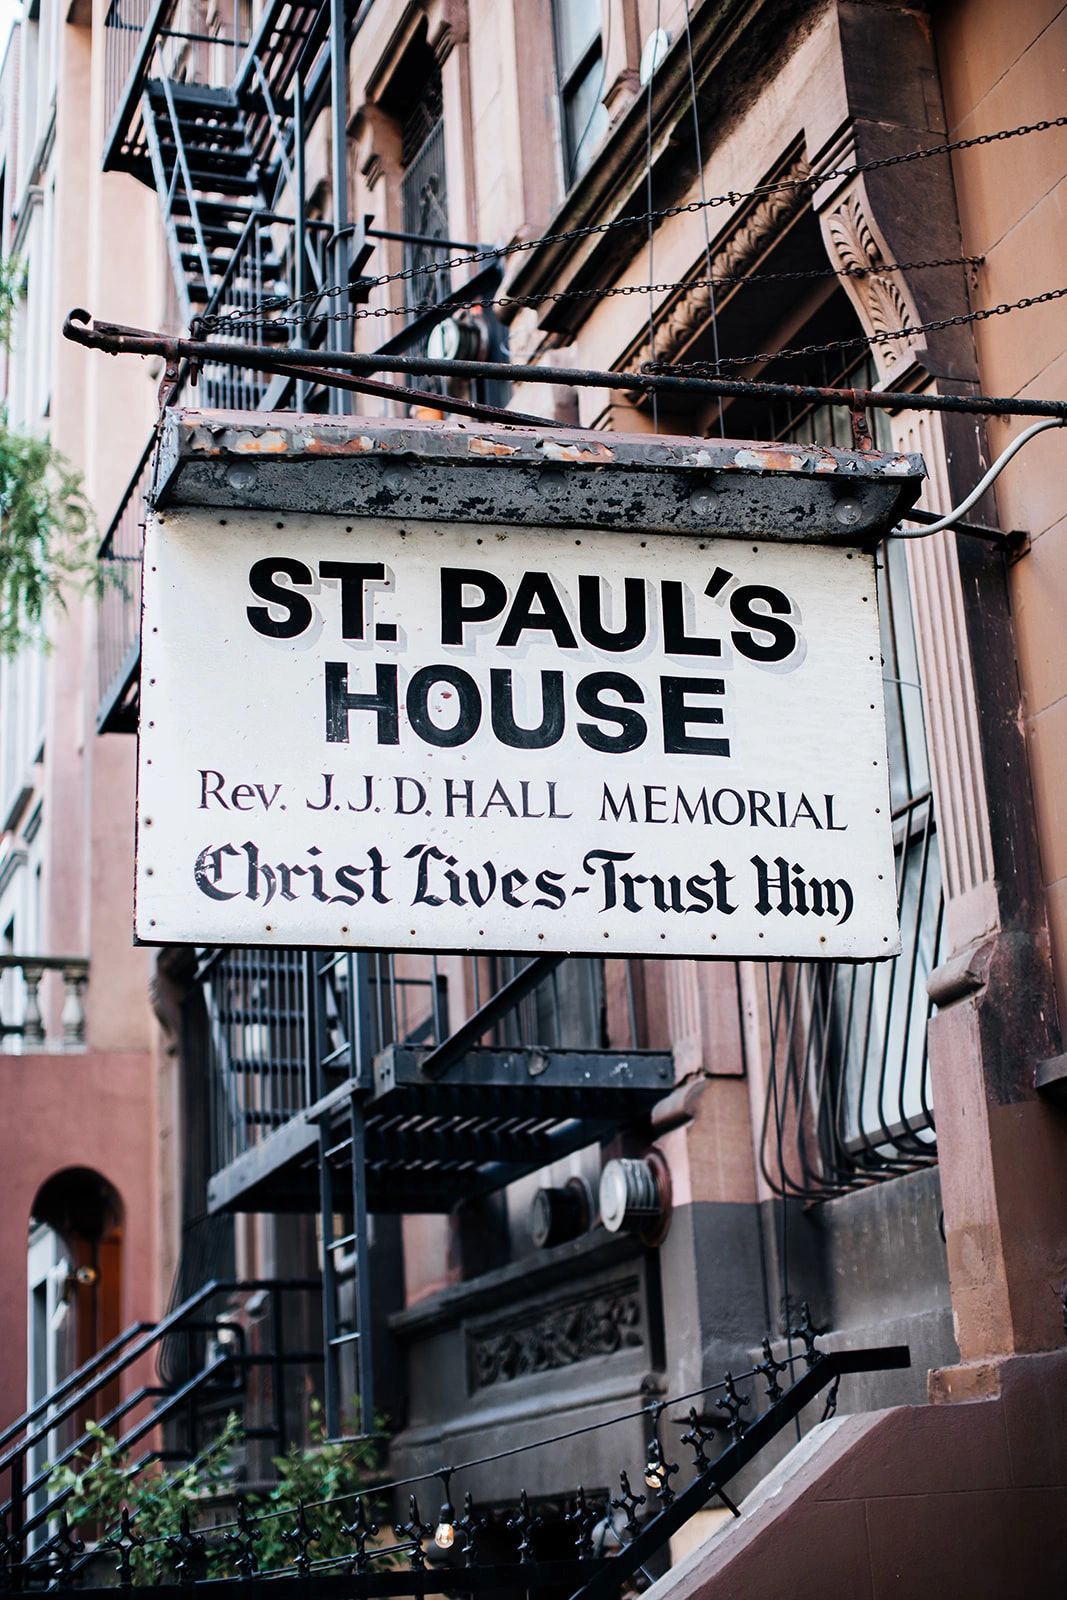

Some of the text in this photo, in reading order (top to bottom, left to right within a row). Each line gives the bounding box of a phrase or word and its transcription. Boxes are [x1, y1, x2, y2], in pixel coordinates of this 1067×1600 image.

[246, 556, 796, 662] ST. PAUL'S
[324, 661, 731, 758] HOUSE
[197, 769, 287, 811] Rev.
[599, 781, 848, 831] MEMORIAL
[194, 840, 393, 907] Christ
[749, 854, 854, 926] Him
